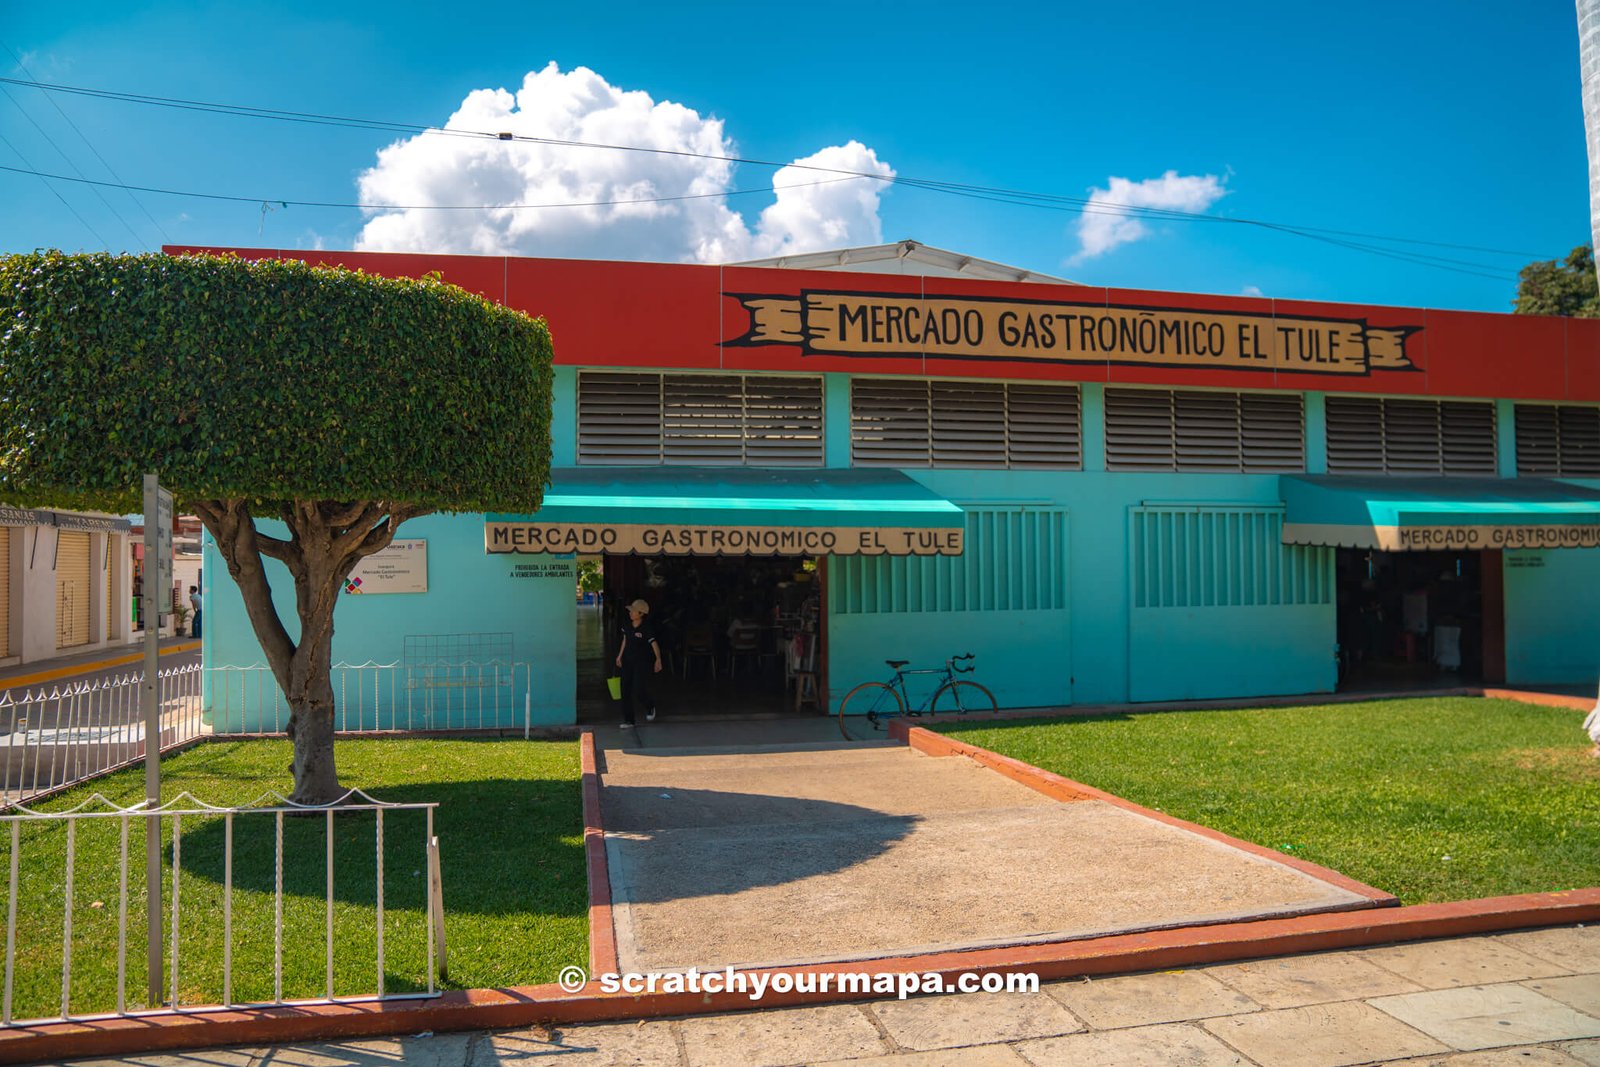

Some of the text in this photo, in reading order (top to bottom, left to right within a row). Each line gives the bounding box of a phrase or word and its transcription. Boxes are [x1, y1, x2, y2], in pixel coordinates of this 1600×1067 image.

[838, 303, 984, 346] MERCADO
[1238, 323, 1268, 360] EL
[1277, 326, 1341, 363] TULE
[493, 527, 959, 548] MERCADO GASTRONOMICO EL TULE
[1400, 529, 1479, 544] MERCADO
